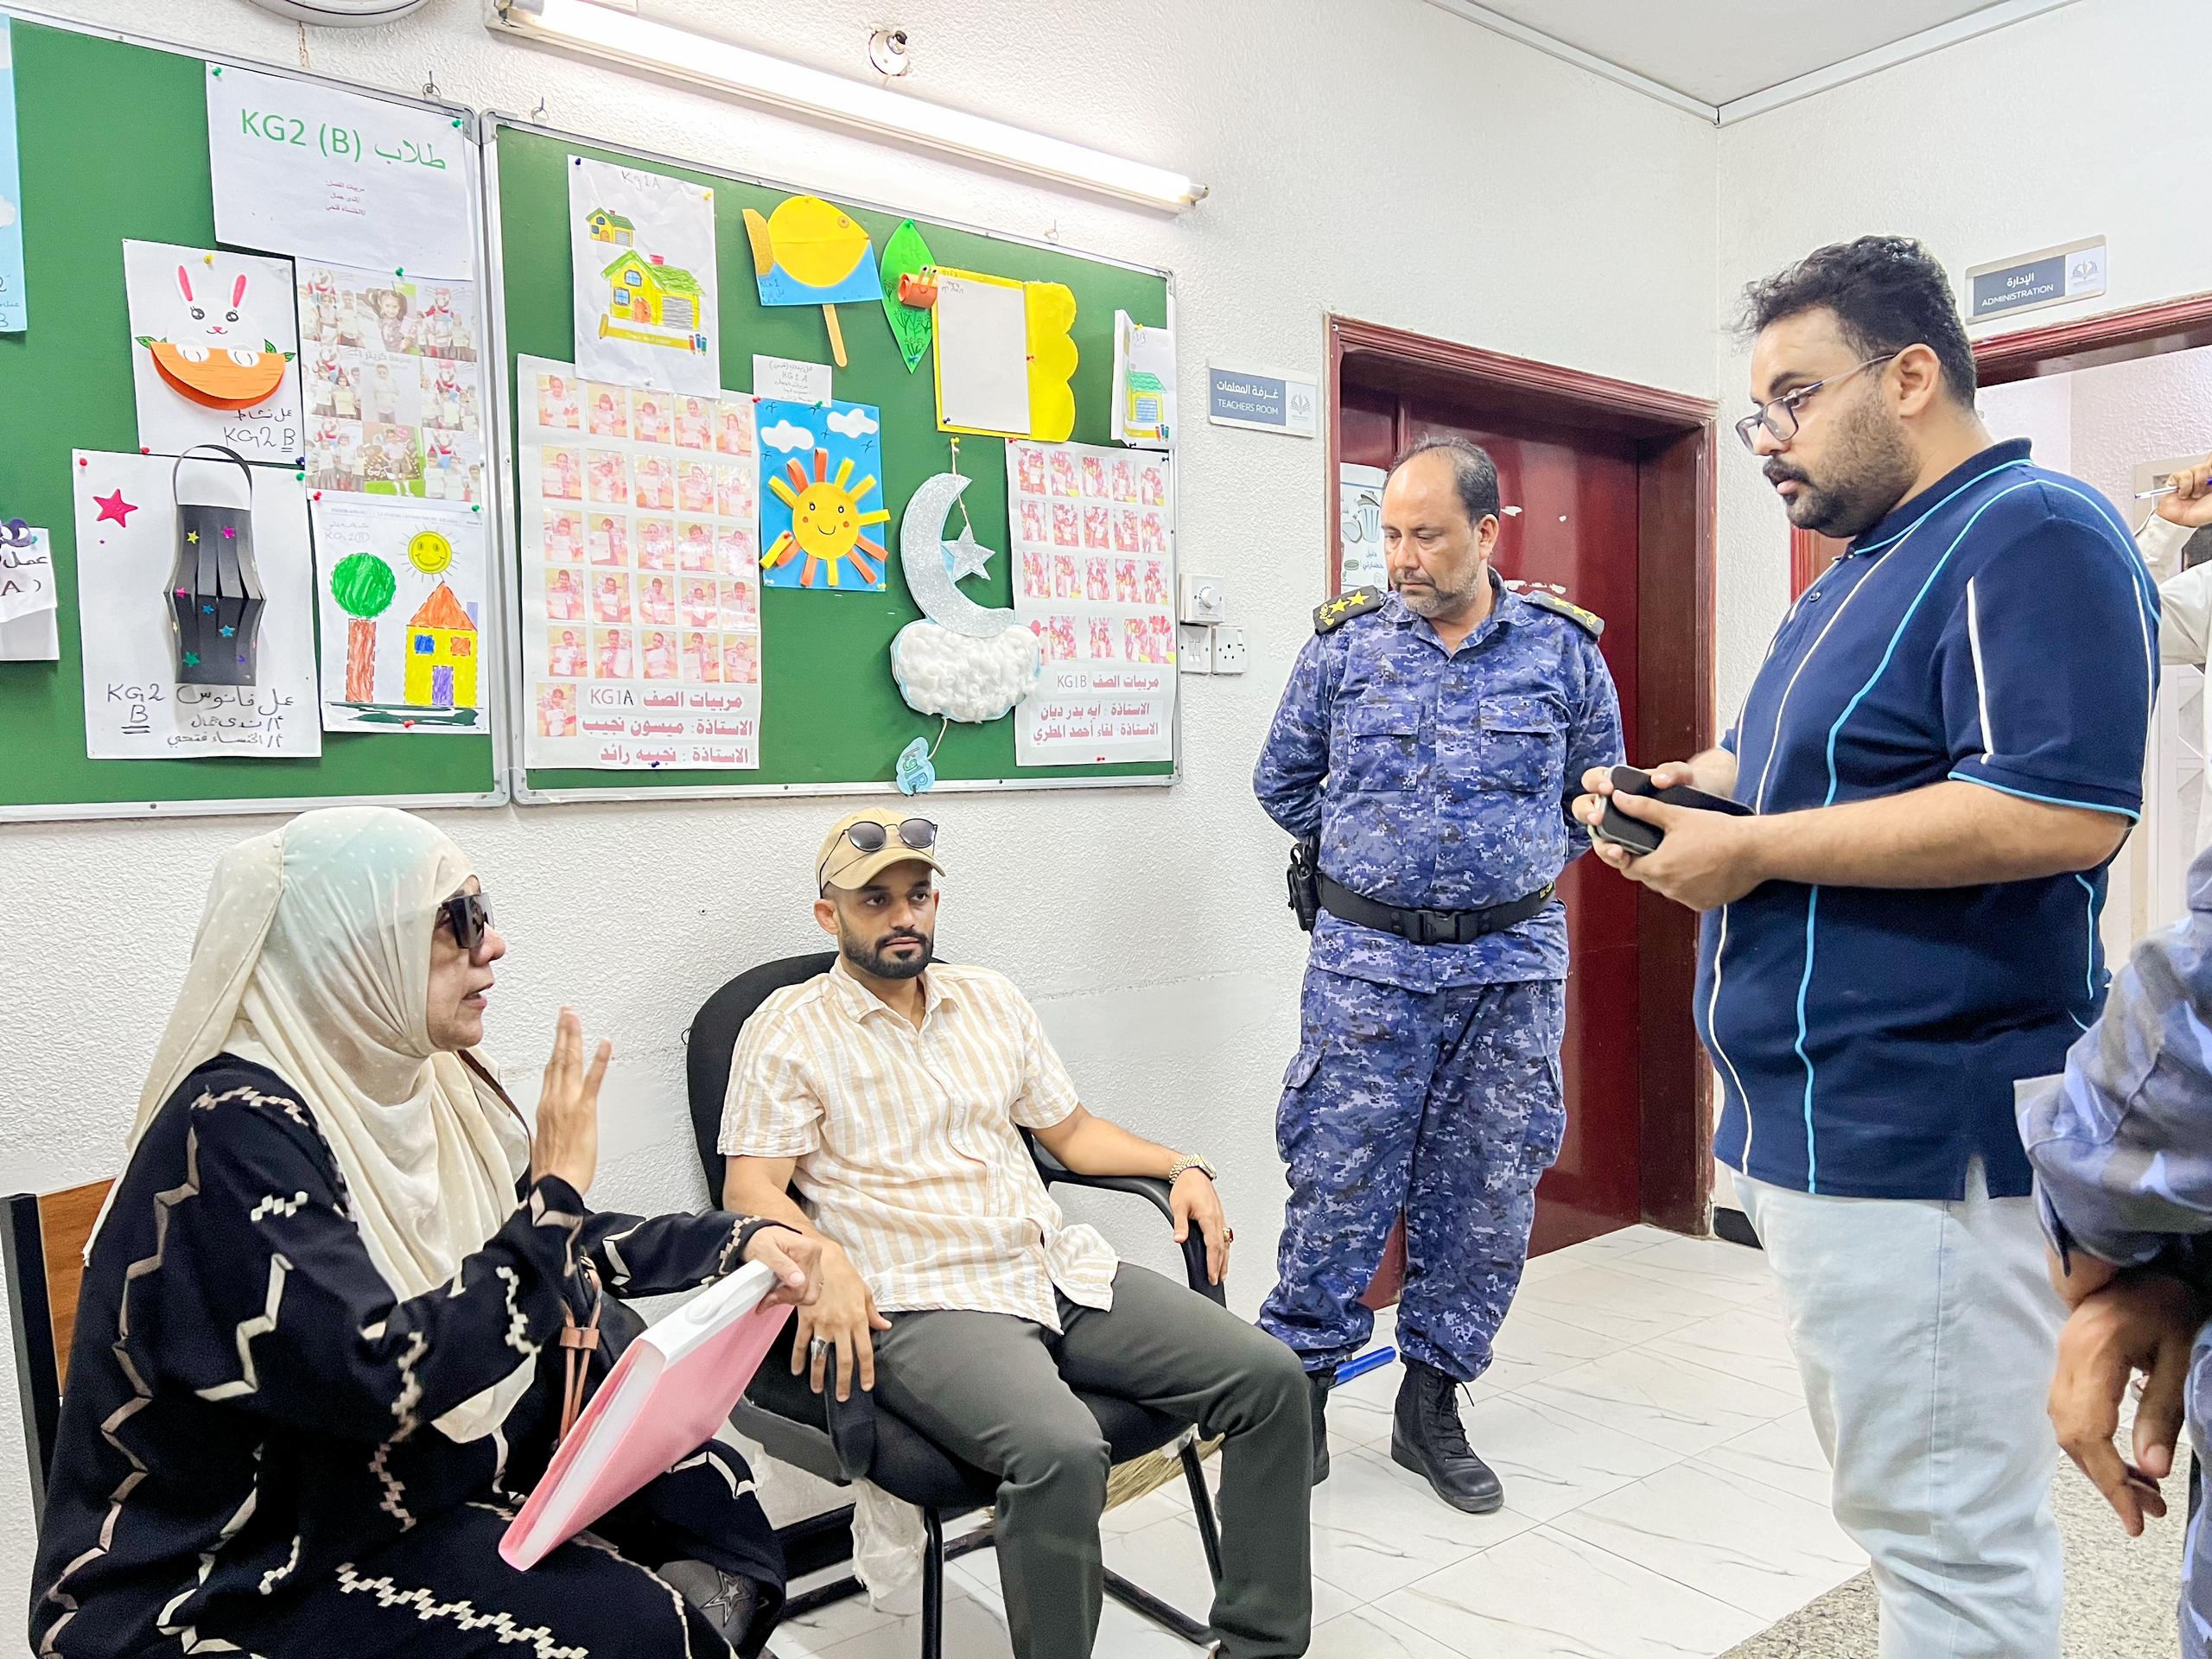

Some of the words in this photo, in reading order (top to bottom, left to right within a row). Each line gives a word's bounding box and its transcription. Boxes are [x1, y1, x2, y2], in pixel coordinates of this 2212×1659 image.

[241, 109, 306, 146] KG2
[320, 123, 361, 162] (B)
[374, 139, 446, 169] طلاب
[1217, 380, 1250, 394] المعلمات
[1252, 385, 1279, 399] غرفة
[1217, 398, 1255, 412] TEACHERS
[1255, 404, 1279, 415] ROOM
[224, 427, 276, 448] KG2
[283, 428, 296, 446] B
[3, 550, 48, 569] عمل
[1057, 675, 1087, 688] KG1B
[1093, 673, 1120, 688] الصف
[1123, 674, 1160, 690] مربيات
[107, 683, 166, 702] KG2
[175, 685, 255, 710] فانوس
[590, 690, 634, 706] KG1A
[643, 690, 684, 708] الصف
[690, 692, 743, 711] مربيات
[130, 704, 149, 723] B
[1065, 706, 1084, 720] بدر
[582, 716, 626, 734] نجيب
[630, 721, 685, 737] ميسون
[1069, 719, 1094, 738] أحمد
[1097, 722, 1114, 737] لقاء
[600, 744, 631, 765] رائد
